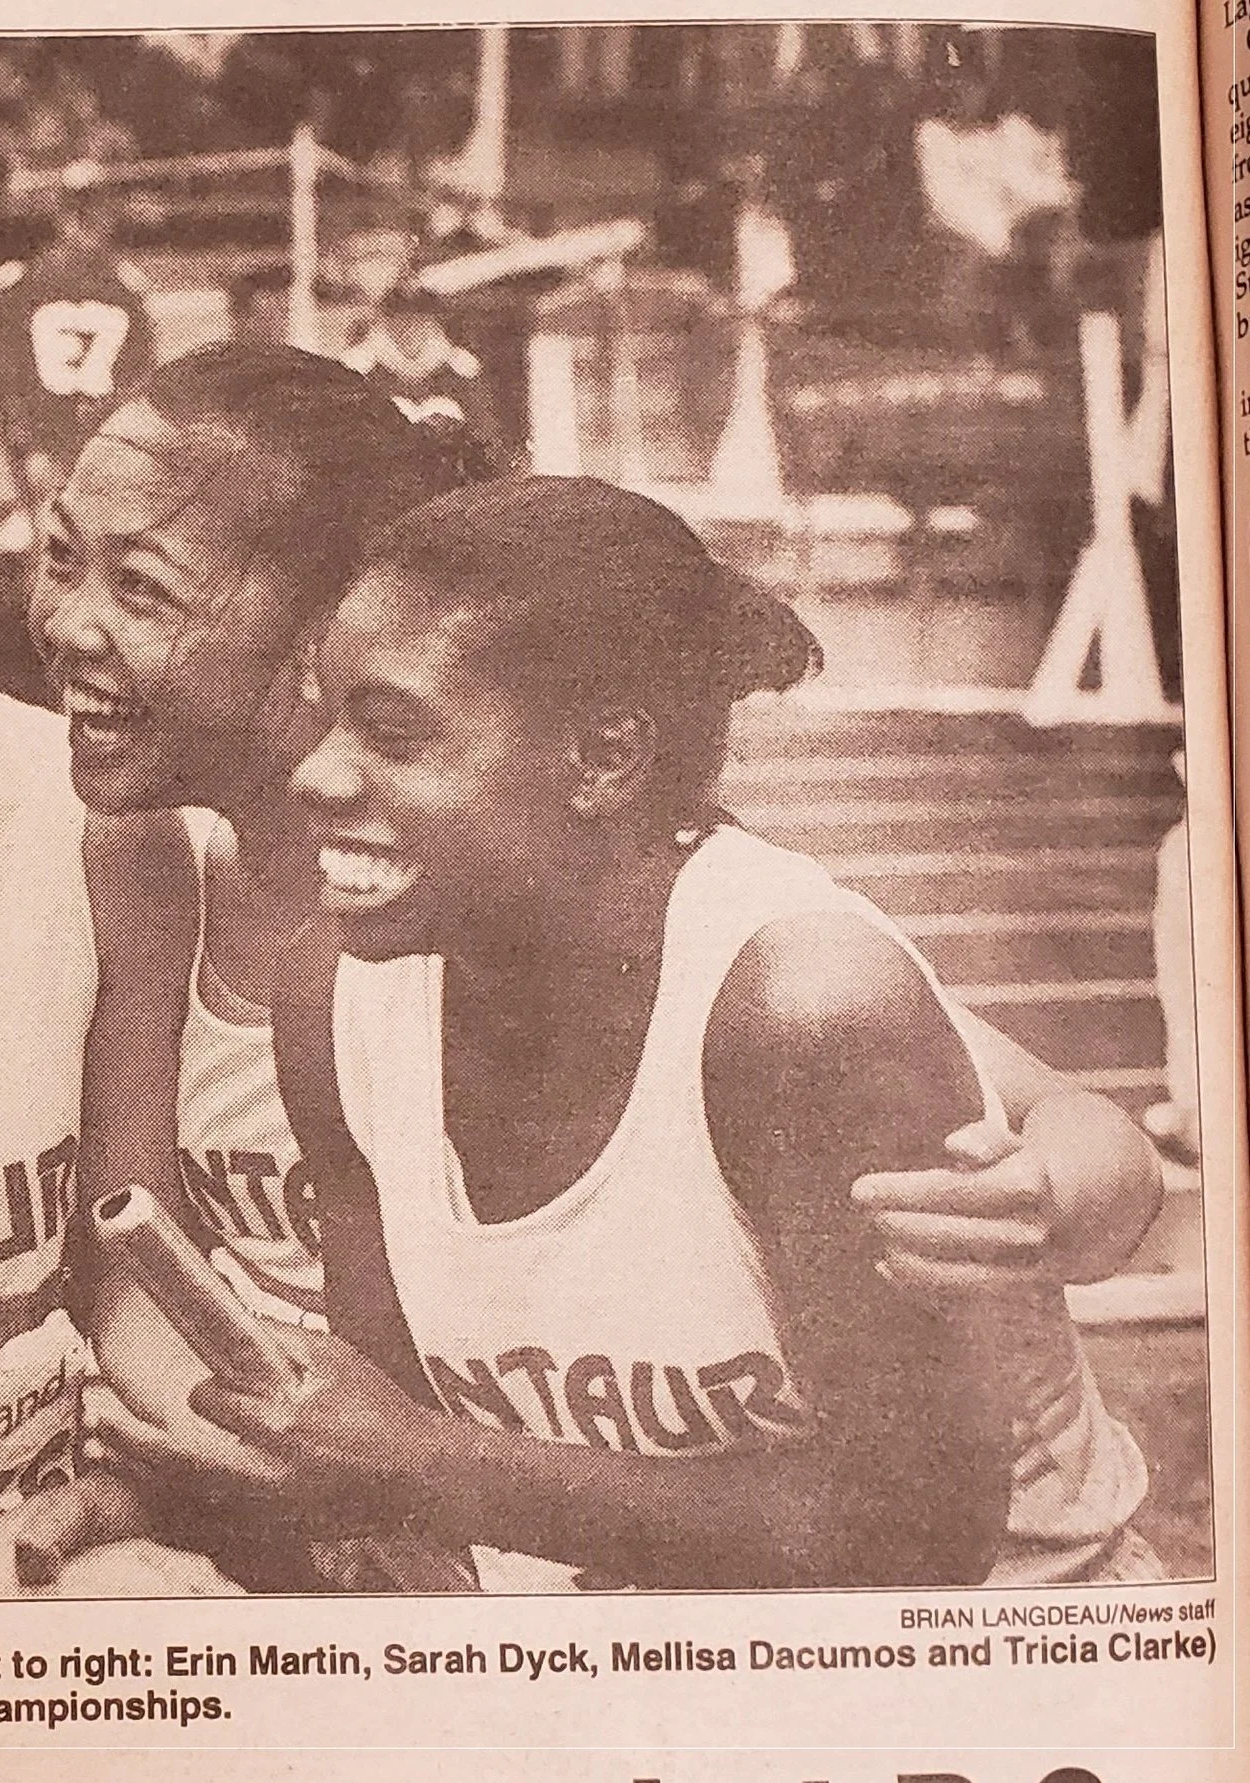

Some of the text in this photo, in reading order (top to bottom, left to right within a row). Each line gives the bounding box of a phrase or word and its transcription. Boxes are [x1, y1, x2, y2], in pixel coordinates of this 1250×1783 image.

[900, 1607, 975, 1629] BRIAN
[1178, 1598, 1216, 1622] staff
[11, 1650, 48, 1679] to
[60, 1646, 152, 1686] right:
[166, 1645, 237, 1677] Erin
[249, 1644, 371, 1681] Martin,
[384, 1643, 487, 1675] Sarah
[499, 1642, 598, 1681] Dyck,
[611, 1640, 736, 1672] Mellisa
[750, 1640, 916, 1670] Dacumos
[928, 1637, 991, 1667] and
[1004, 1633, 1098, 1665] Tricia
[1108, 1627, 1216, 1665] Clarke)
